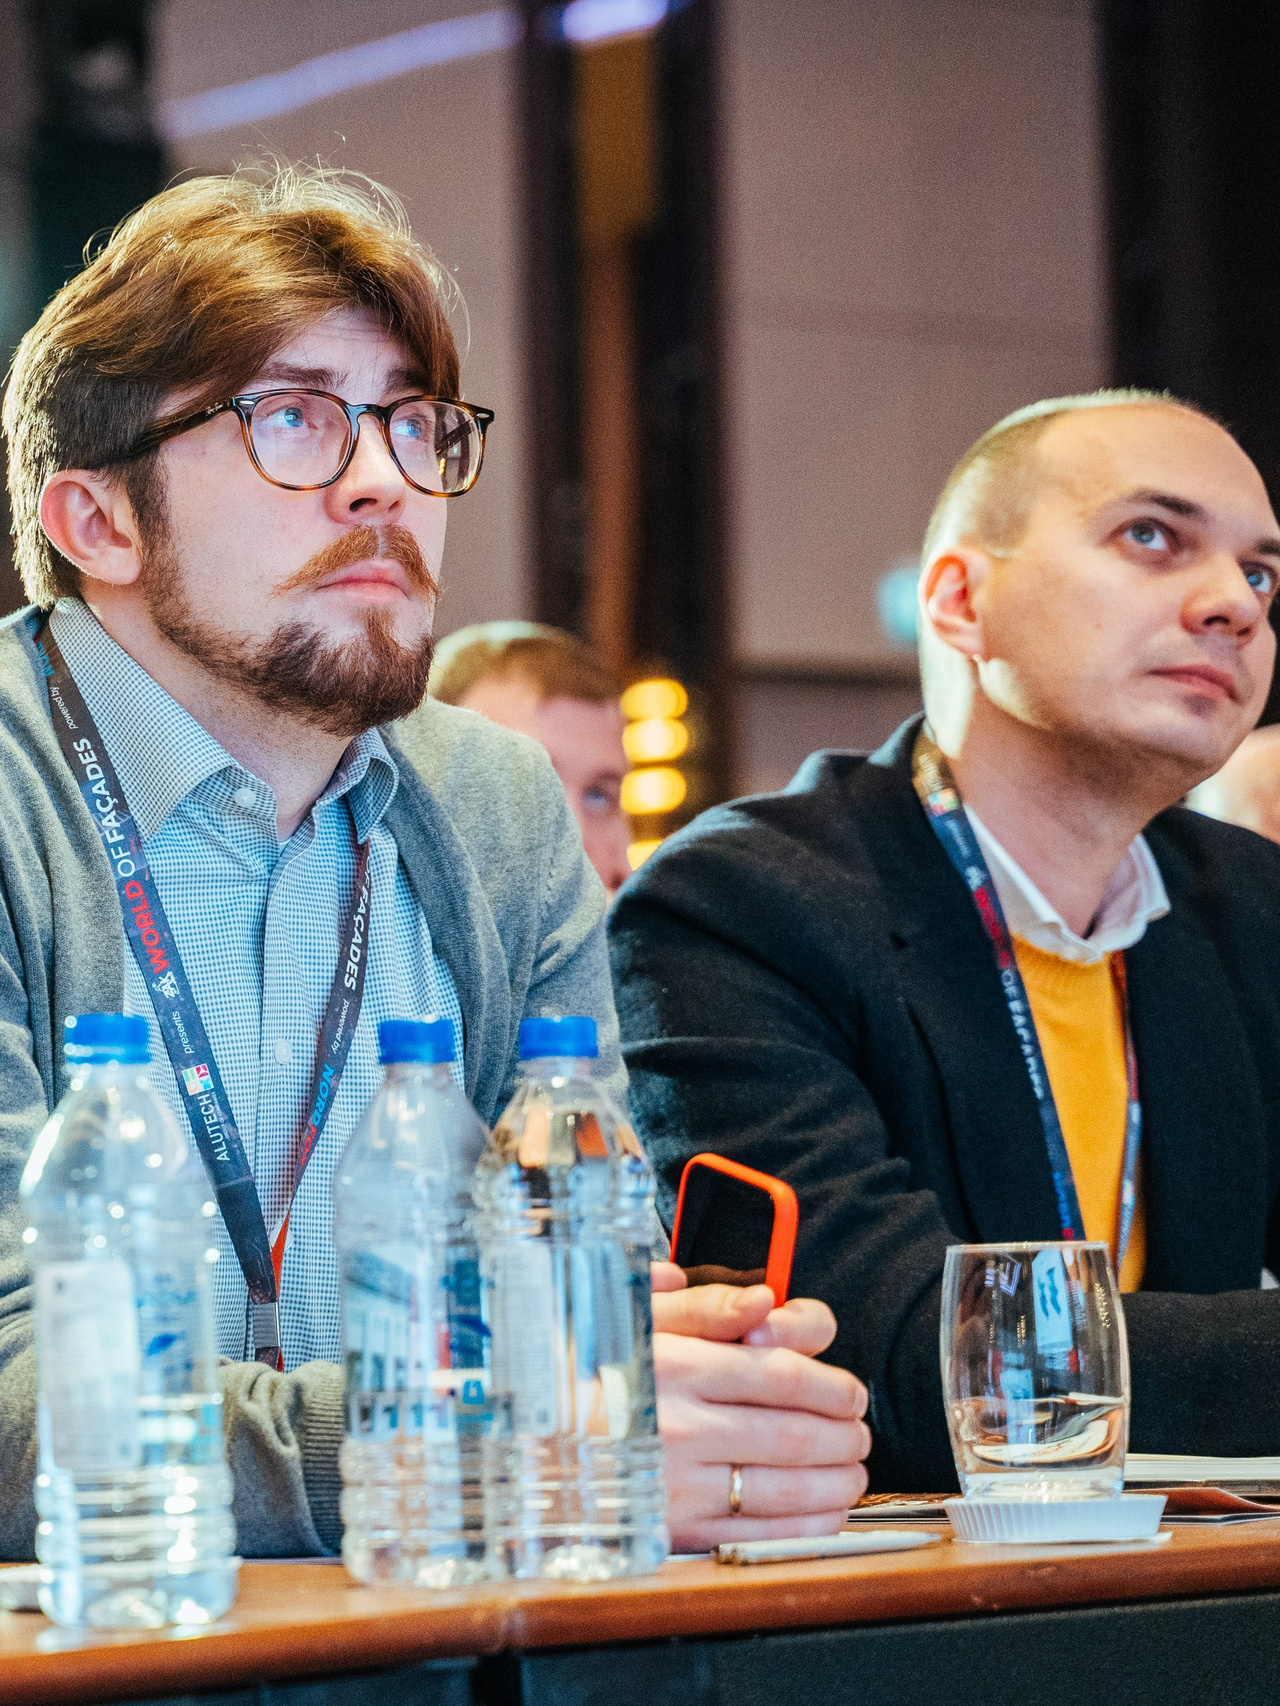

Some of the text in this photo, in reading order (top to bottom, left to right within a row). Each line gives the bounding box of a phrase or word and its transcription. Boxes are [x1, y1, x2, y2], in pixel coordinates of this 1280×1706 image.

[49, 686, 60, 698] by
[53, 697, 78, 730] powered
[72, 738, 125, 844] FAÇADES
[110, 846, 136, 878] OF
[124, 880, 169, 974] WORLD
[344, 885, 369, 991] FAÇADES
[172, 1010, 195, 1055] presents
[335, 999, 350, 1043] powered
[198, 1095, 230, 1161] ALUTECH
